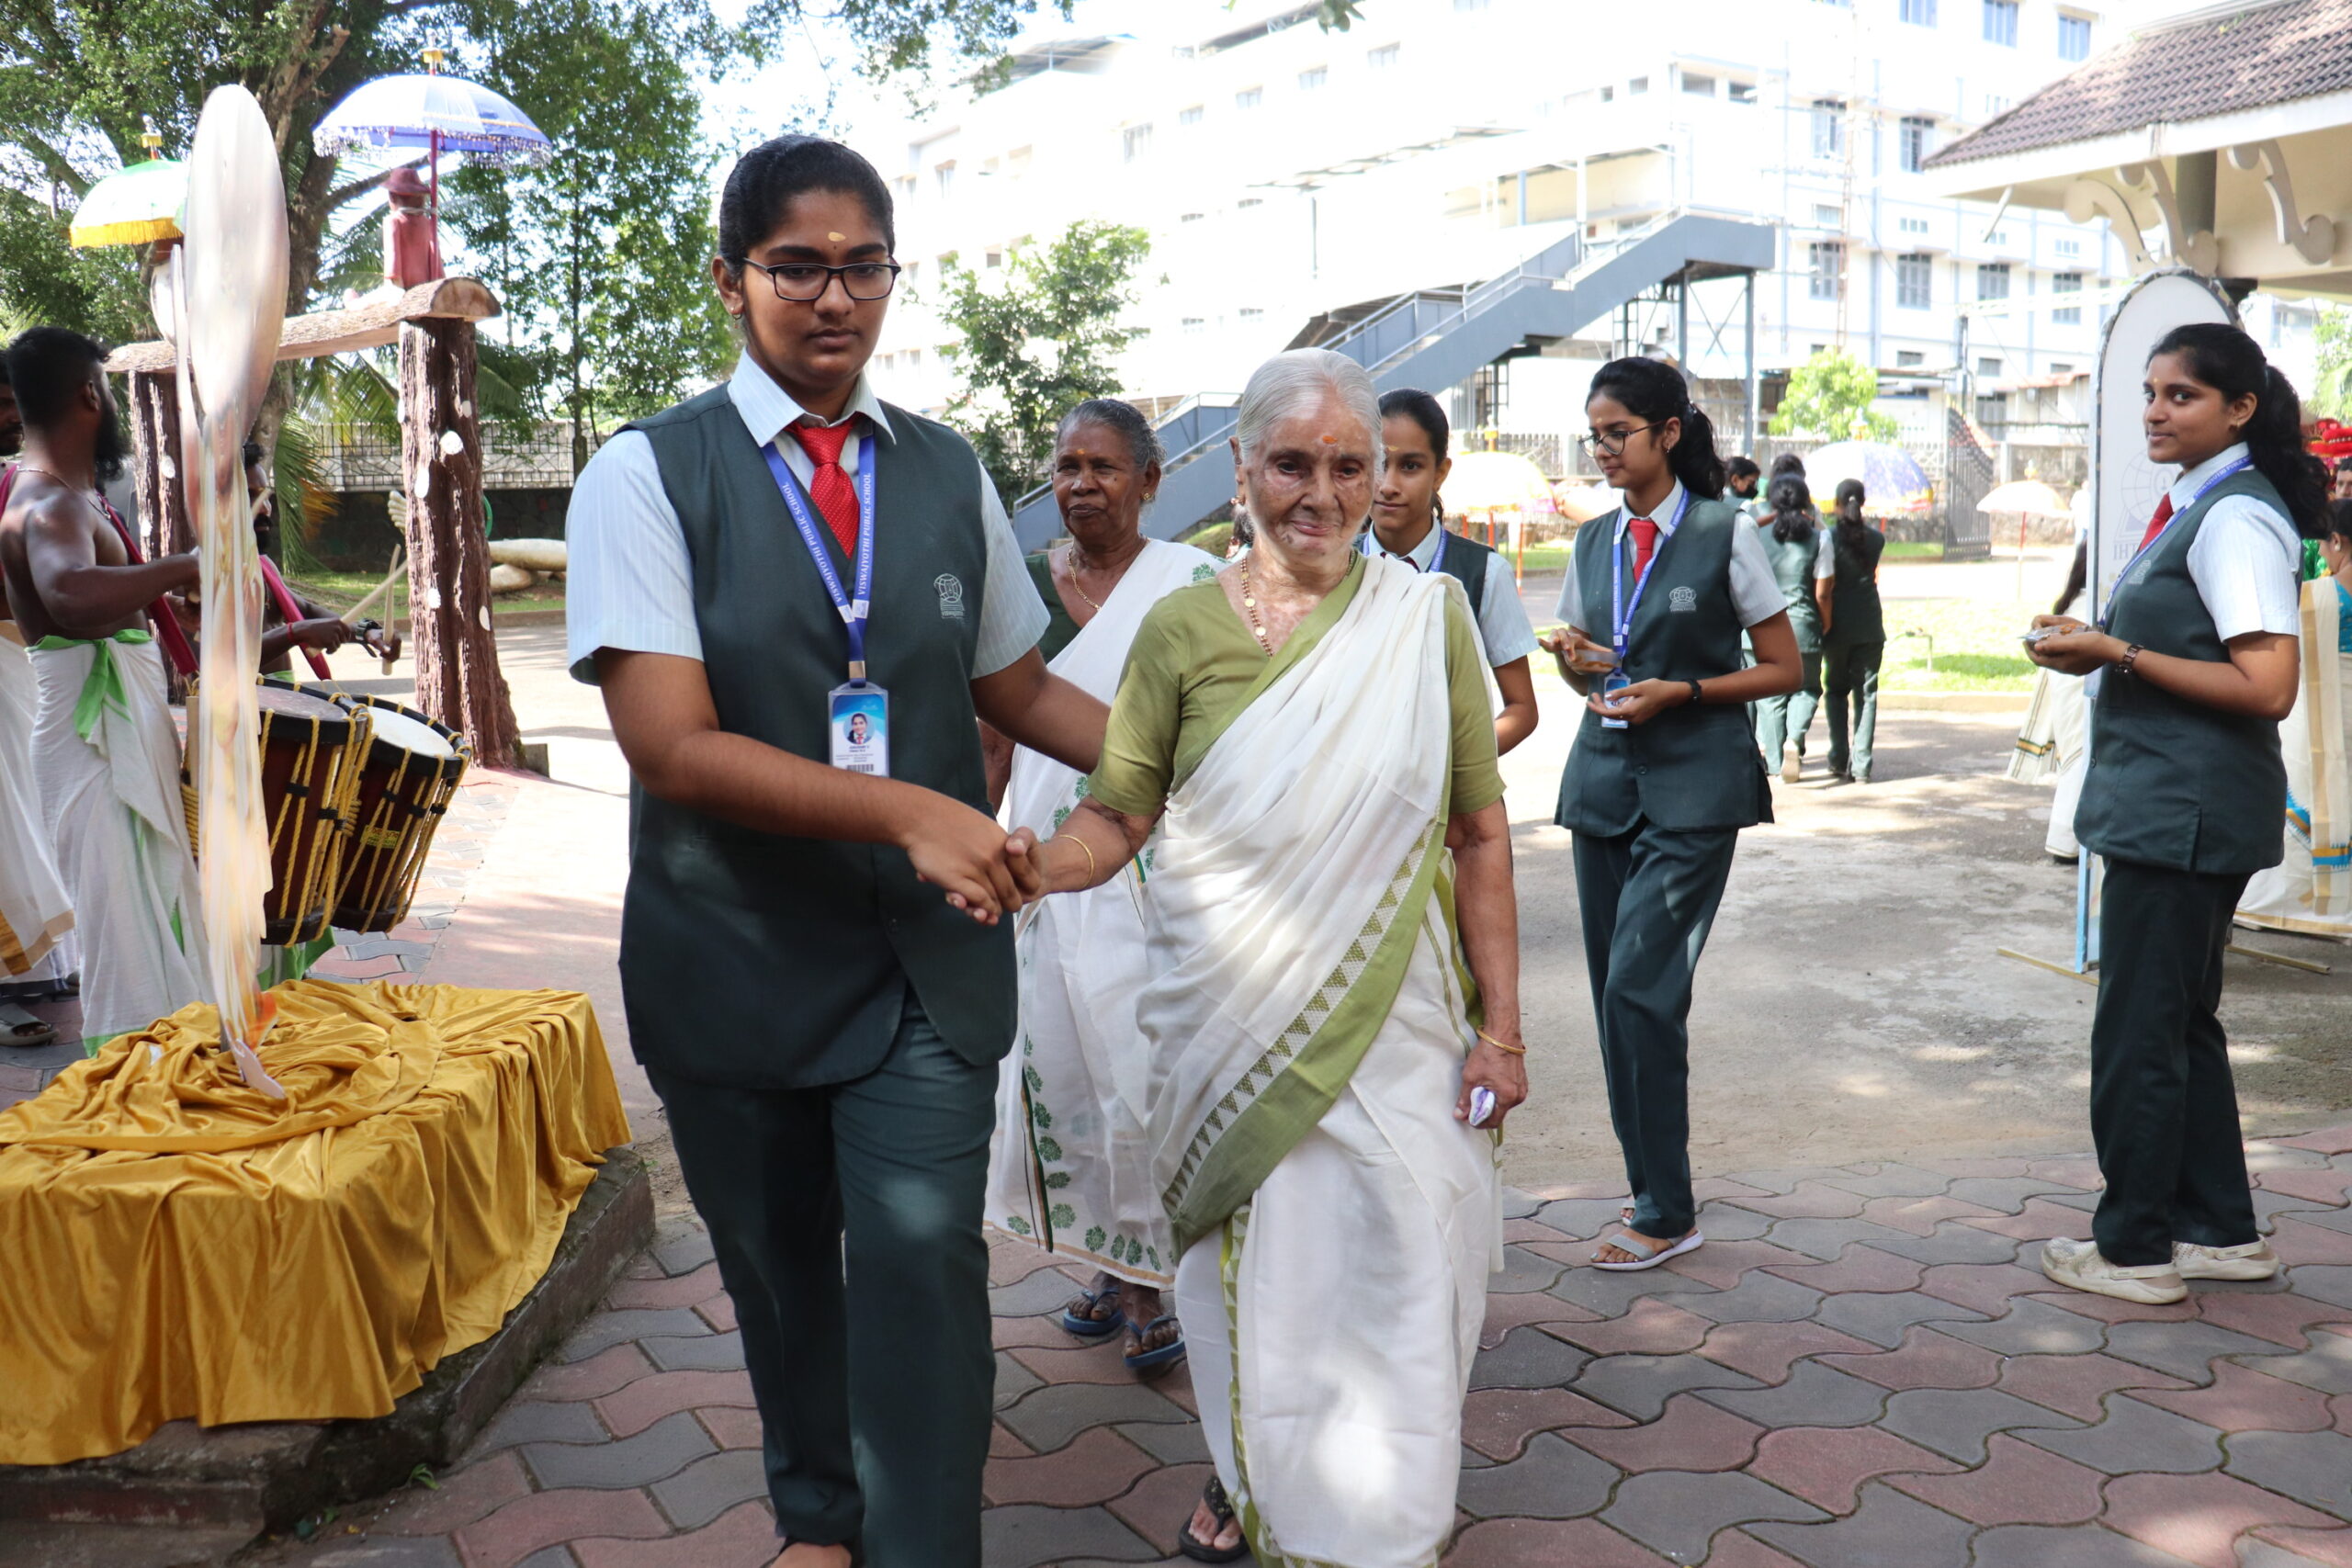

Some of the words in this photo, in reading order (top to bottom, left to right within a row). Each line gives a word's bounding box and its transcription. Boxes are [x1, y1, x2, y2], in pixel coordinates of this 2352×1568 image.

[782, 481, 802, 515] SCHOOL
[797, 514, 817, 546] PUBLIC
[812, 544, 842, 603] VISWAJYOTHI
[858, 537, 870, 596] VISWAJYOTHI
